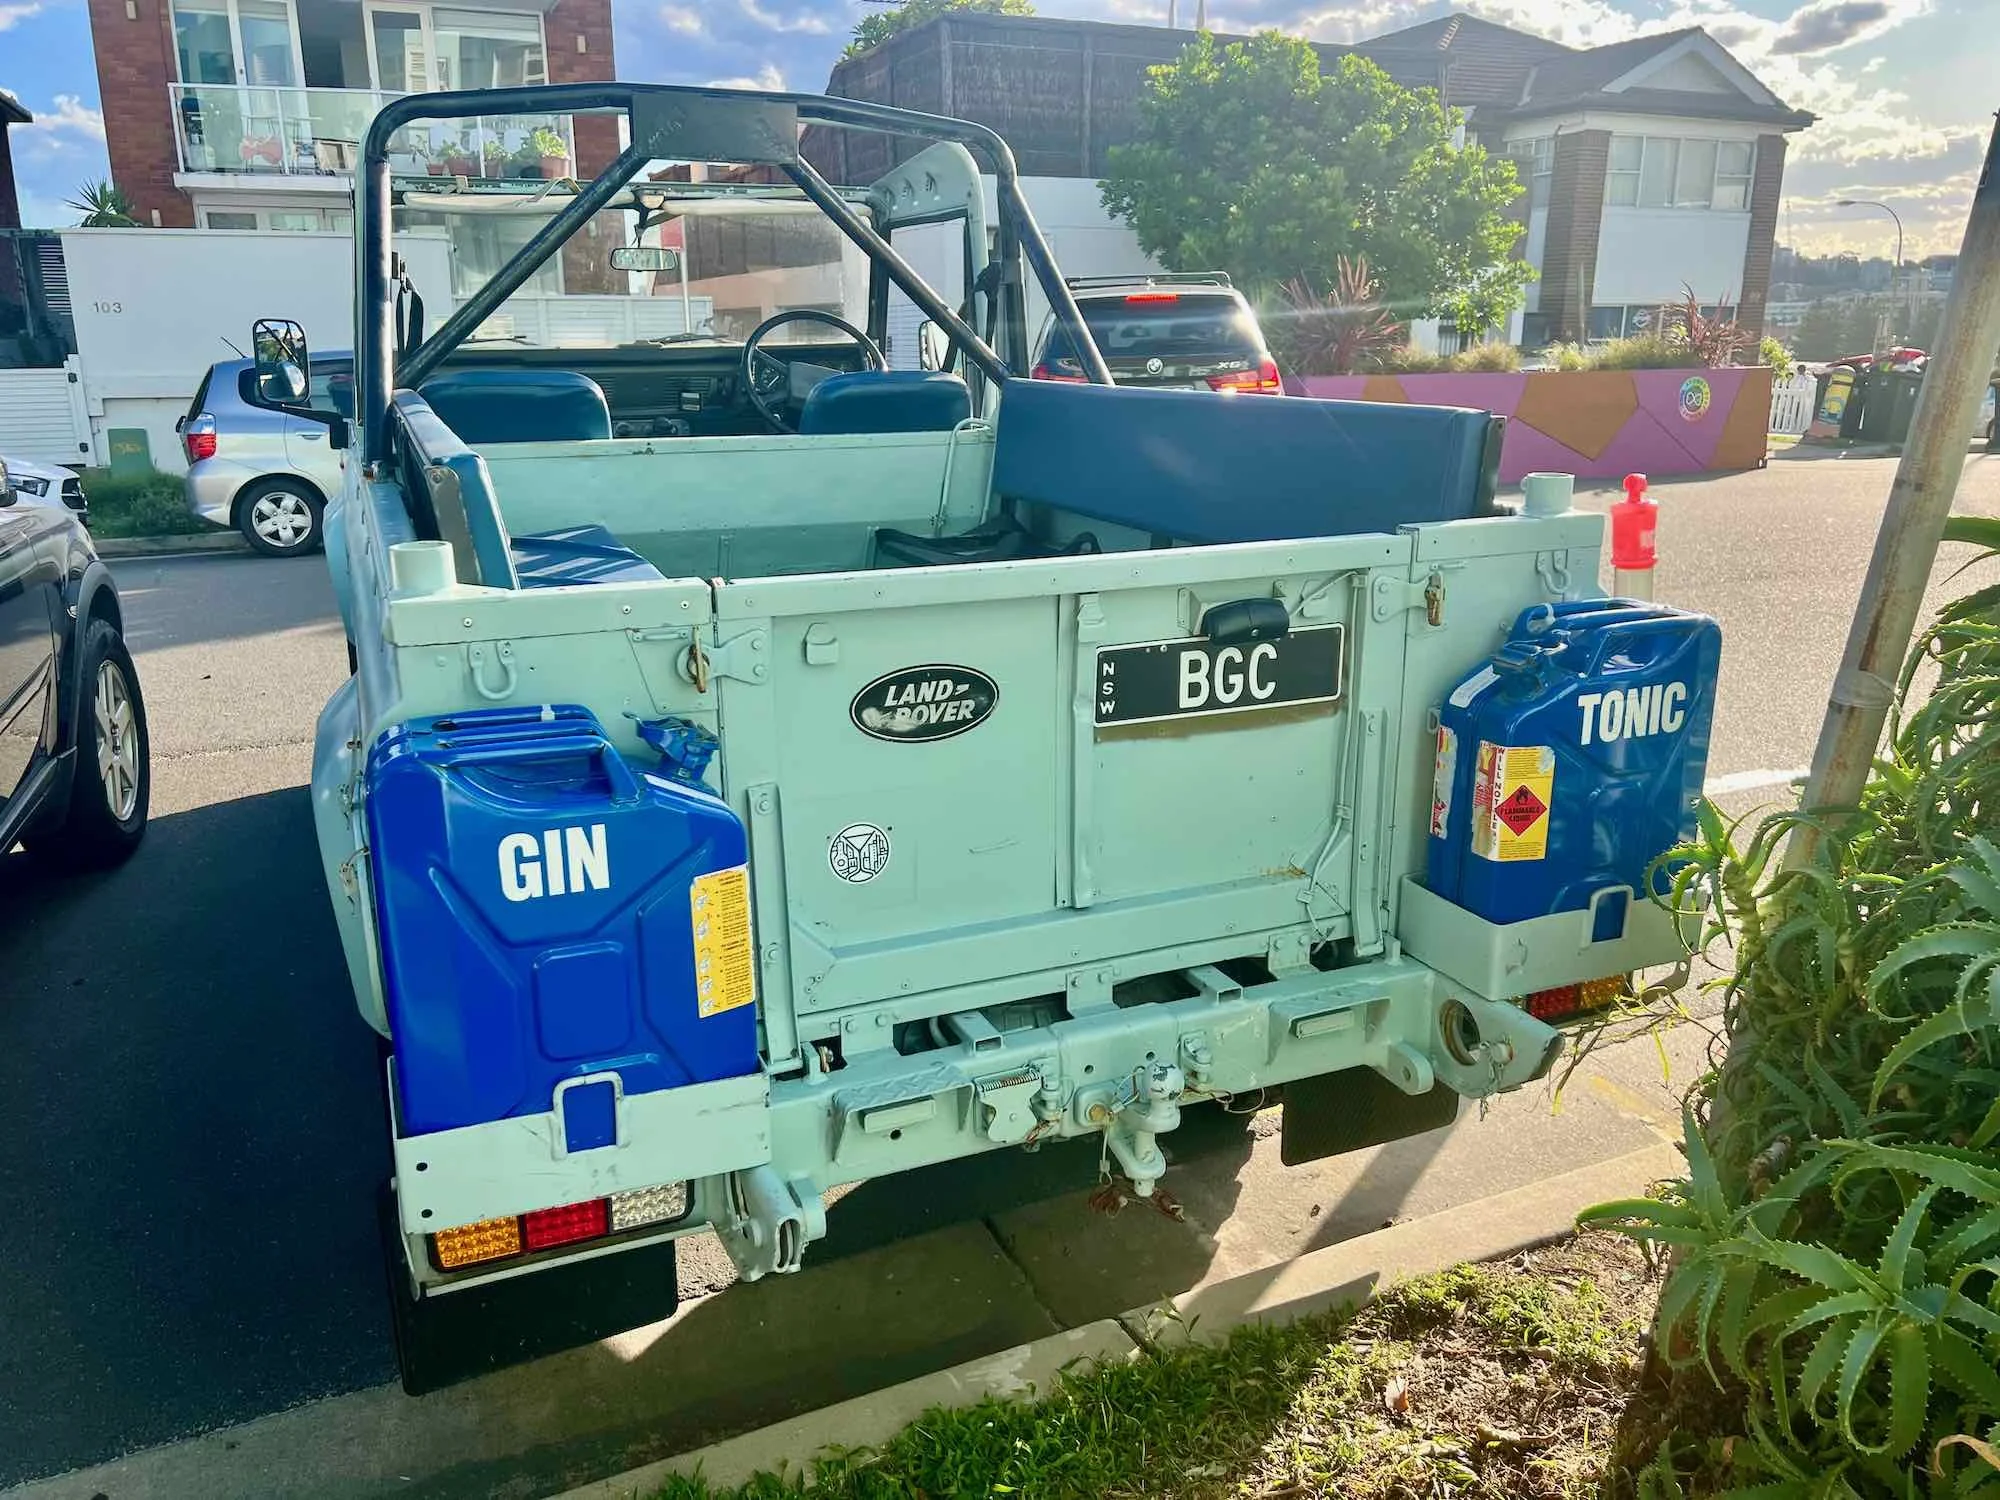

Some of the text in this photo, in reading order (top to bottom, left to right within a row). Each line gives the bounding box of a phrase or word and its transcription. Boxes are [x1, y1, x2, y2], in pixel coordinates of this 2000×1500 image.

[93, 301, 122, 313] 103
[1100, 662, 1115, 715] NSW
[1179, 643, 1278, 709] BGC
[894, 699, 976, 725] ROVER
[1578, 682, 1686, 745] TONIC
[498, 823, 610, 902] GIN
